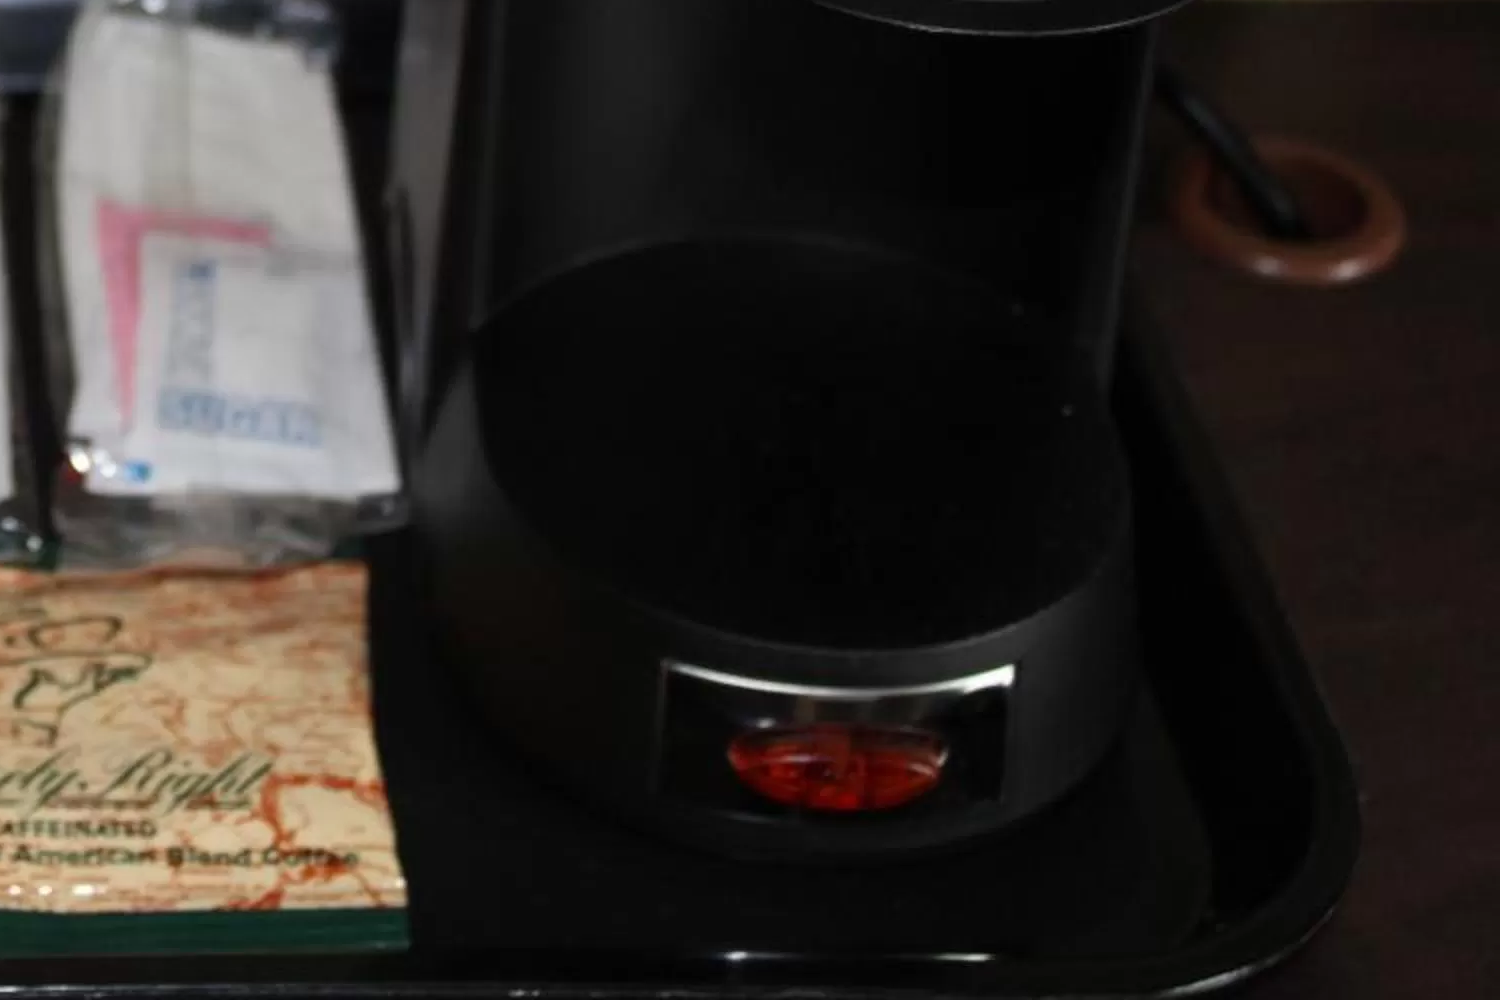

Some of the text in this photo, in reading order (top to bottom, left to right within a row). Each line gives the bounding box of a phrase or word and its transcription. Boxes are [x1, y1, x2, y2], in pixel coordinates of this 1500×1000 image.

[95, 748, 277, 816] Right
[11, 843, 155, 866] American
[166, 846, 252, 867] Blend
